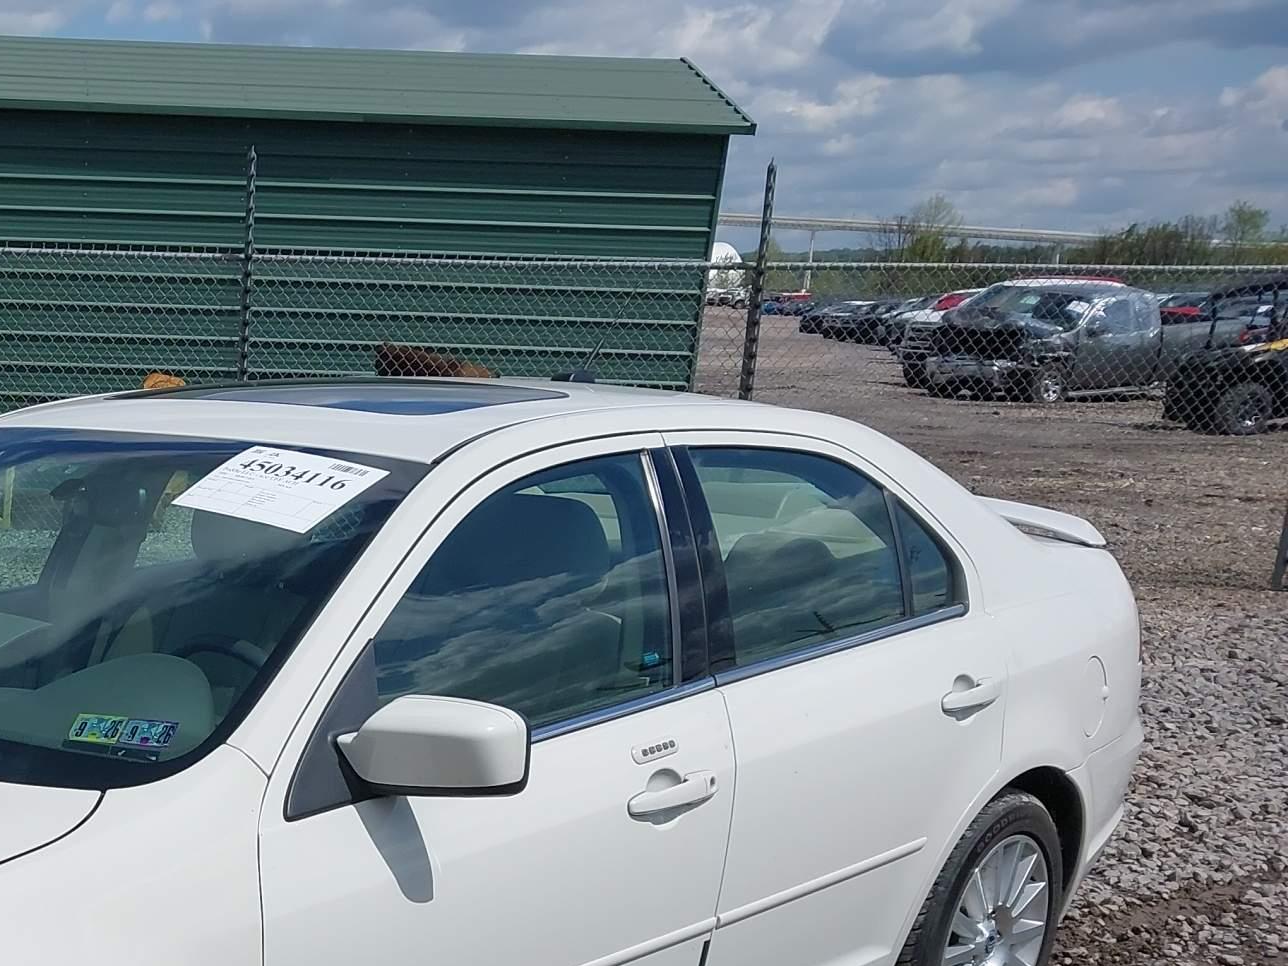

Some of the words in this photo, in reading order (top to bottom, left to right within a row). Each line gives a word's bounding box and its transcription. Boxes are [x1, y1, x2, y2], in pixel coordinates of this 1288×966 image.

[239, 459, 348, 491] 45034116
[74, 721, 88, 737] 9
[104, 720, 122, 738] 26
[127, 725, 139, 741] 9
[156, 725, 175, 744] 26
